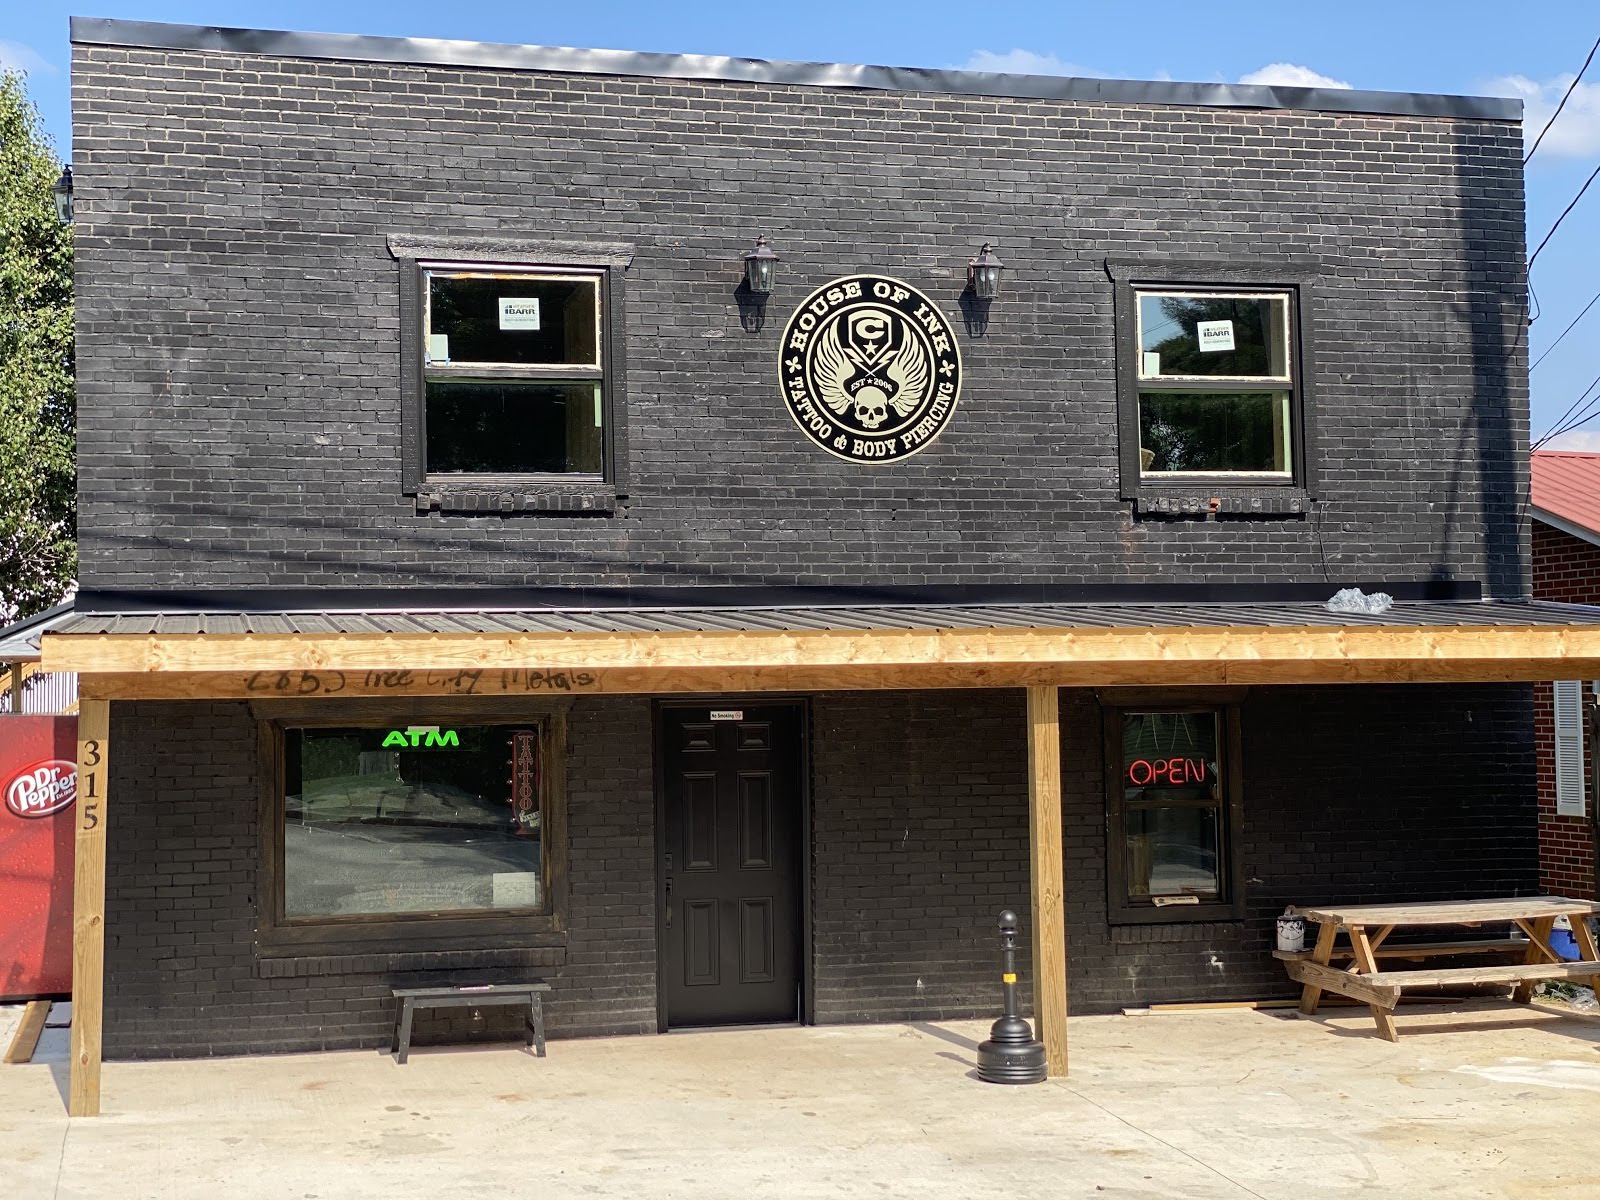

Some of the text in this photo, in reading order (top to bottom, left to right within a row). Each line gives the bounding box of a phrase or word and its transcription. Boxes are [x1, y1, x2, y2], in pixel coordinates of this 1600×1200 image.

[790, 281, 951, 356] HOUSE OF INK
[855, 318, 886, 340] C
[851, 377, 893, 392] EST 2006
[788, 376, 954, 457] TATTOO & BODY PIERCING
[382, 731, 459, 747] ATM
[34, 767, 60, 788] Dr
[83, 740, 101, 830] 315
[1130, 758, 1204, 785] OPEN
[10, 772, 77, 812] Pepper
